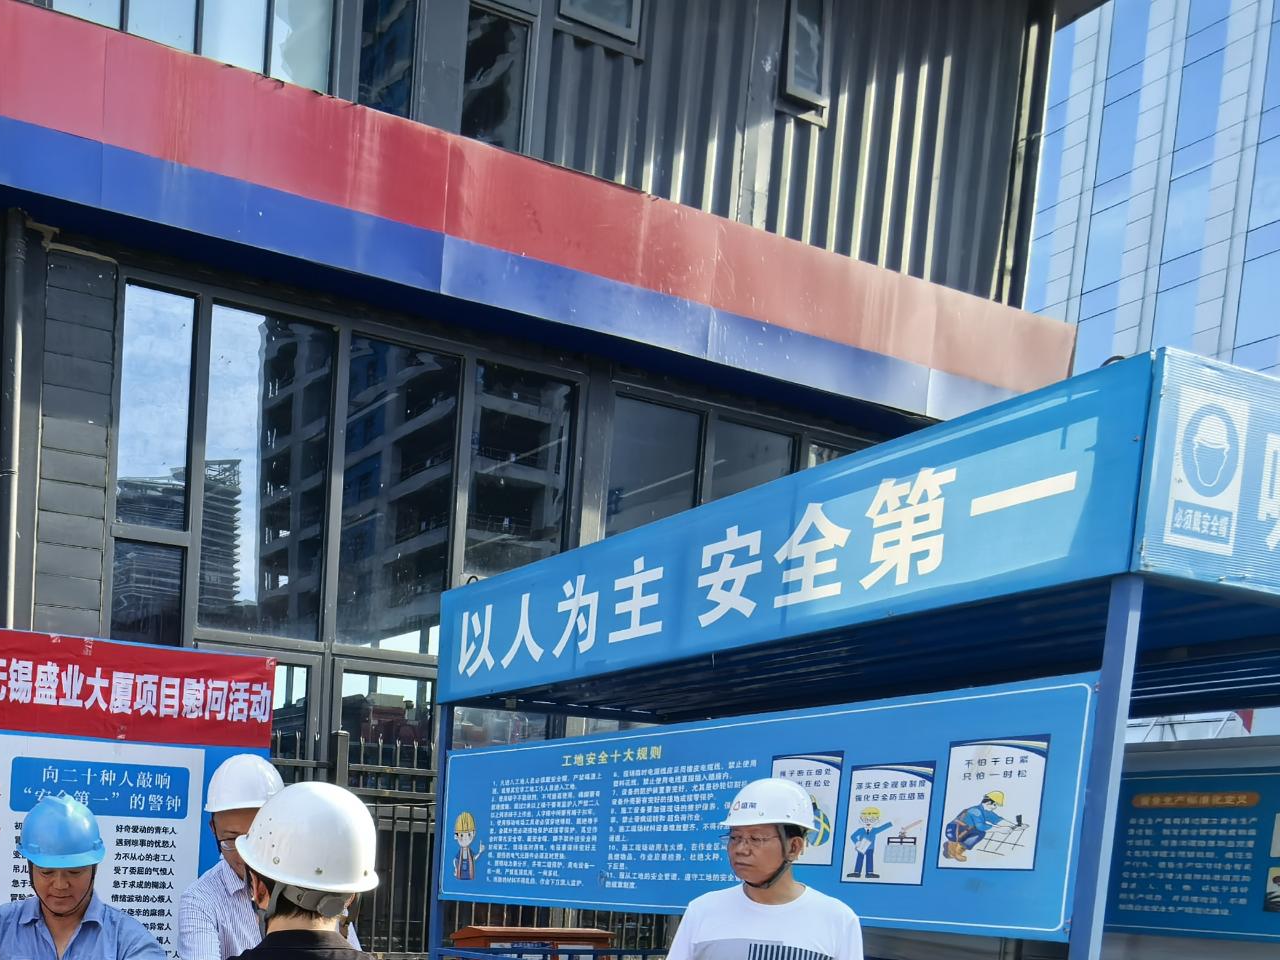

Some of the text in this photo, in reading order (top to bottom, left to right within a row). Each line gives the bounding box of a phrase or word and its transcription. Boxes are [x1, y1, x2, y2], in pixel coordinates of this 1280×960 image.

[458, 467, 1077, 677] 以人为主 安全第一
[561, 745, 663, 767] 工地安全十大规则
[41, 765, 171, 790] 向二十种人敲响
[115, 824, 177, 835] 好奇爱动的青年人
[114, 852, 176, 863] 力不从心的老工人
